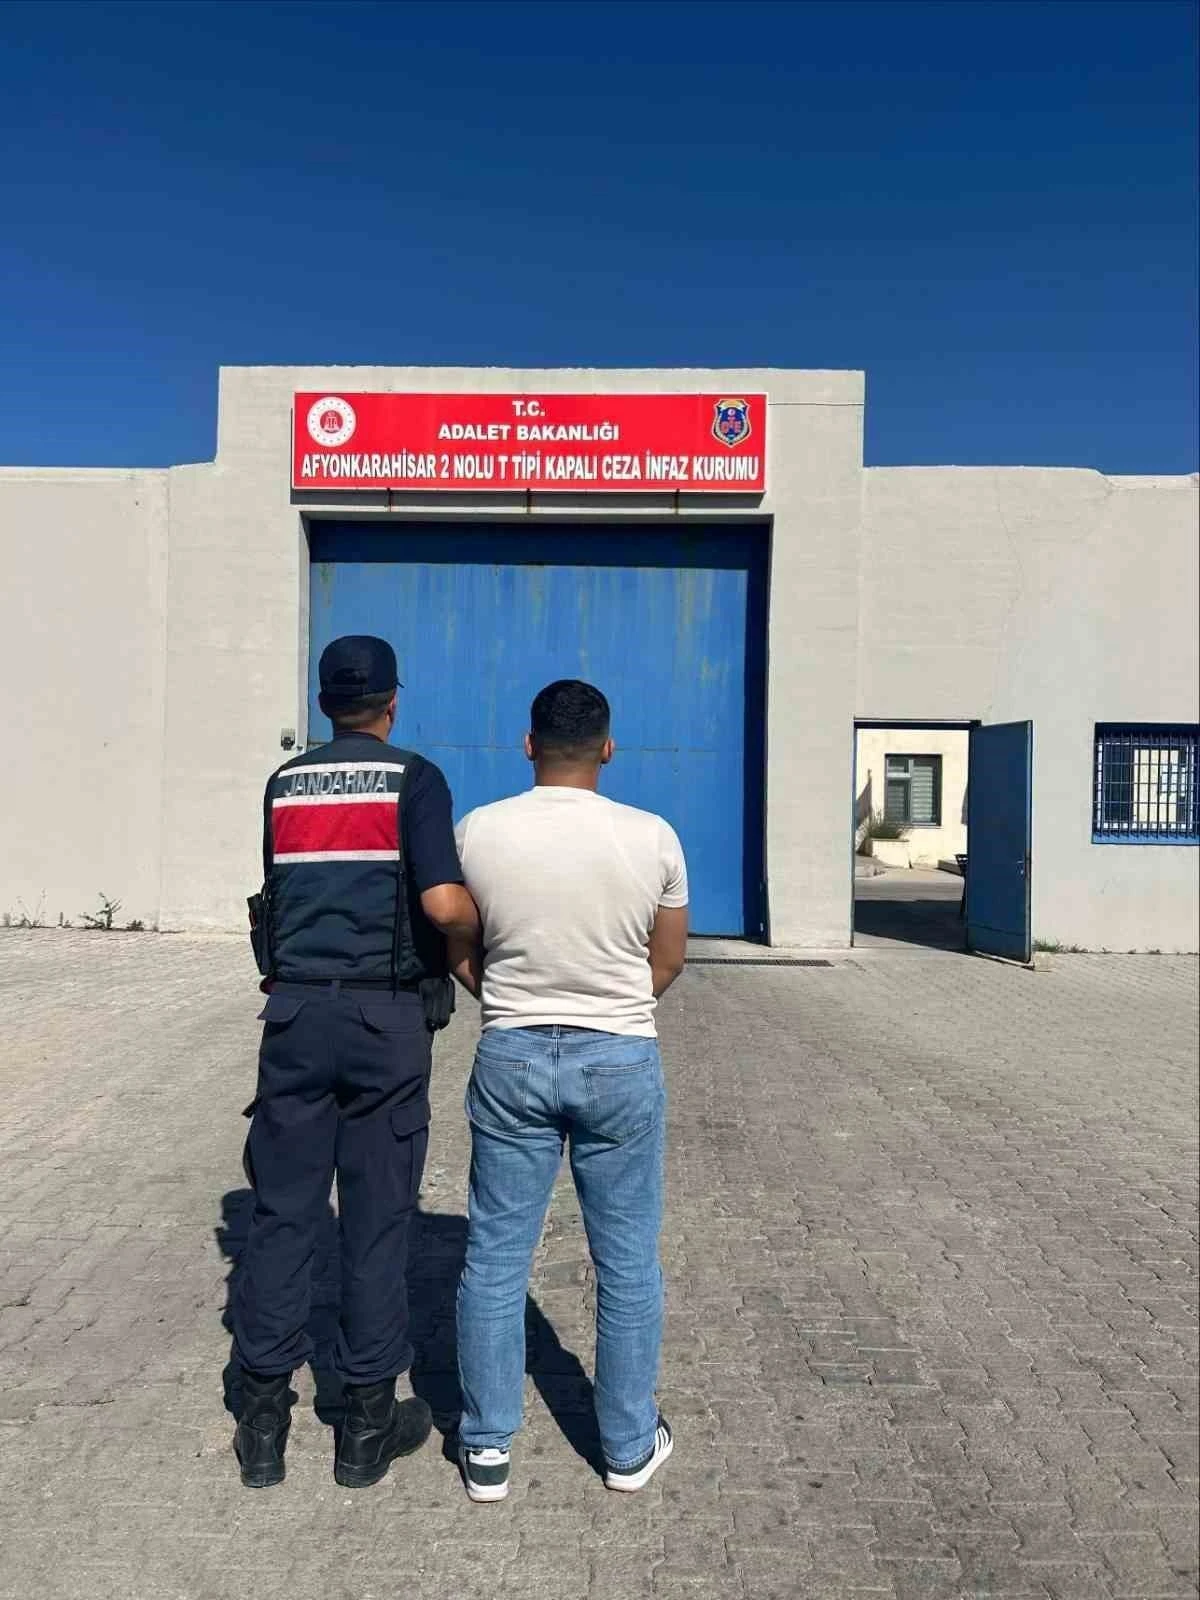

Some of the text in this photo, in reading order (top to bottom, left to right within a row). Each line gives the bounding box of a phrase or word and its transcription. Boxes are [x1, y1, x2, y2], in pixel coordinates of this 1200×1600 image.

[512, 400, 545, 416] T.C.
[438, 421, 620, 441] ADALET BAKANLIĞI
[301, 448, 759, 481] AFYONKARAHİSAR 2 NOLU T TİPİ KAPALI CEZA İNFAZ KURUMU
[285, 771, 388, 796] JANDARMA
